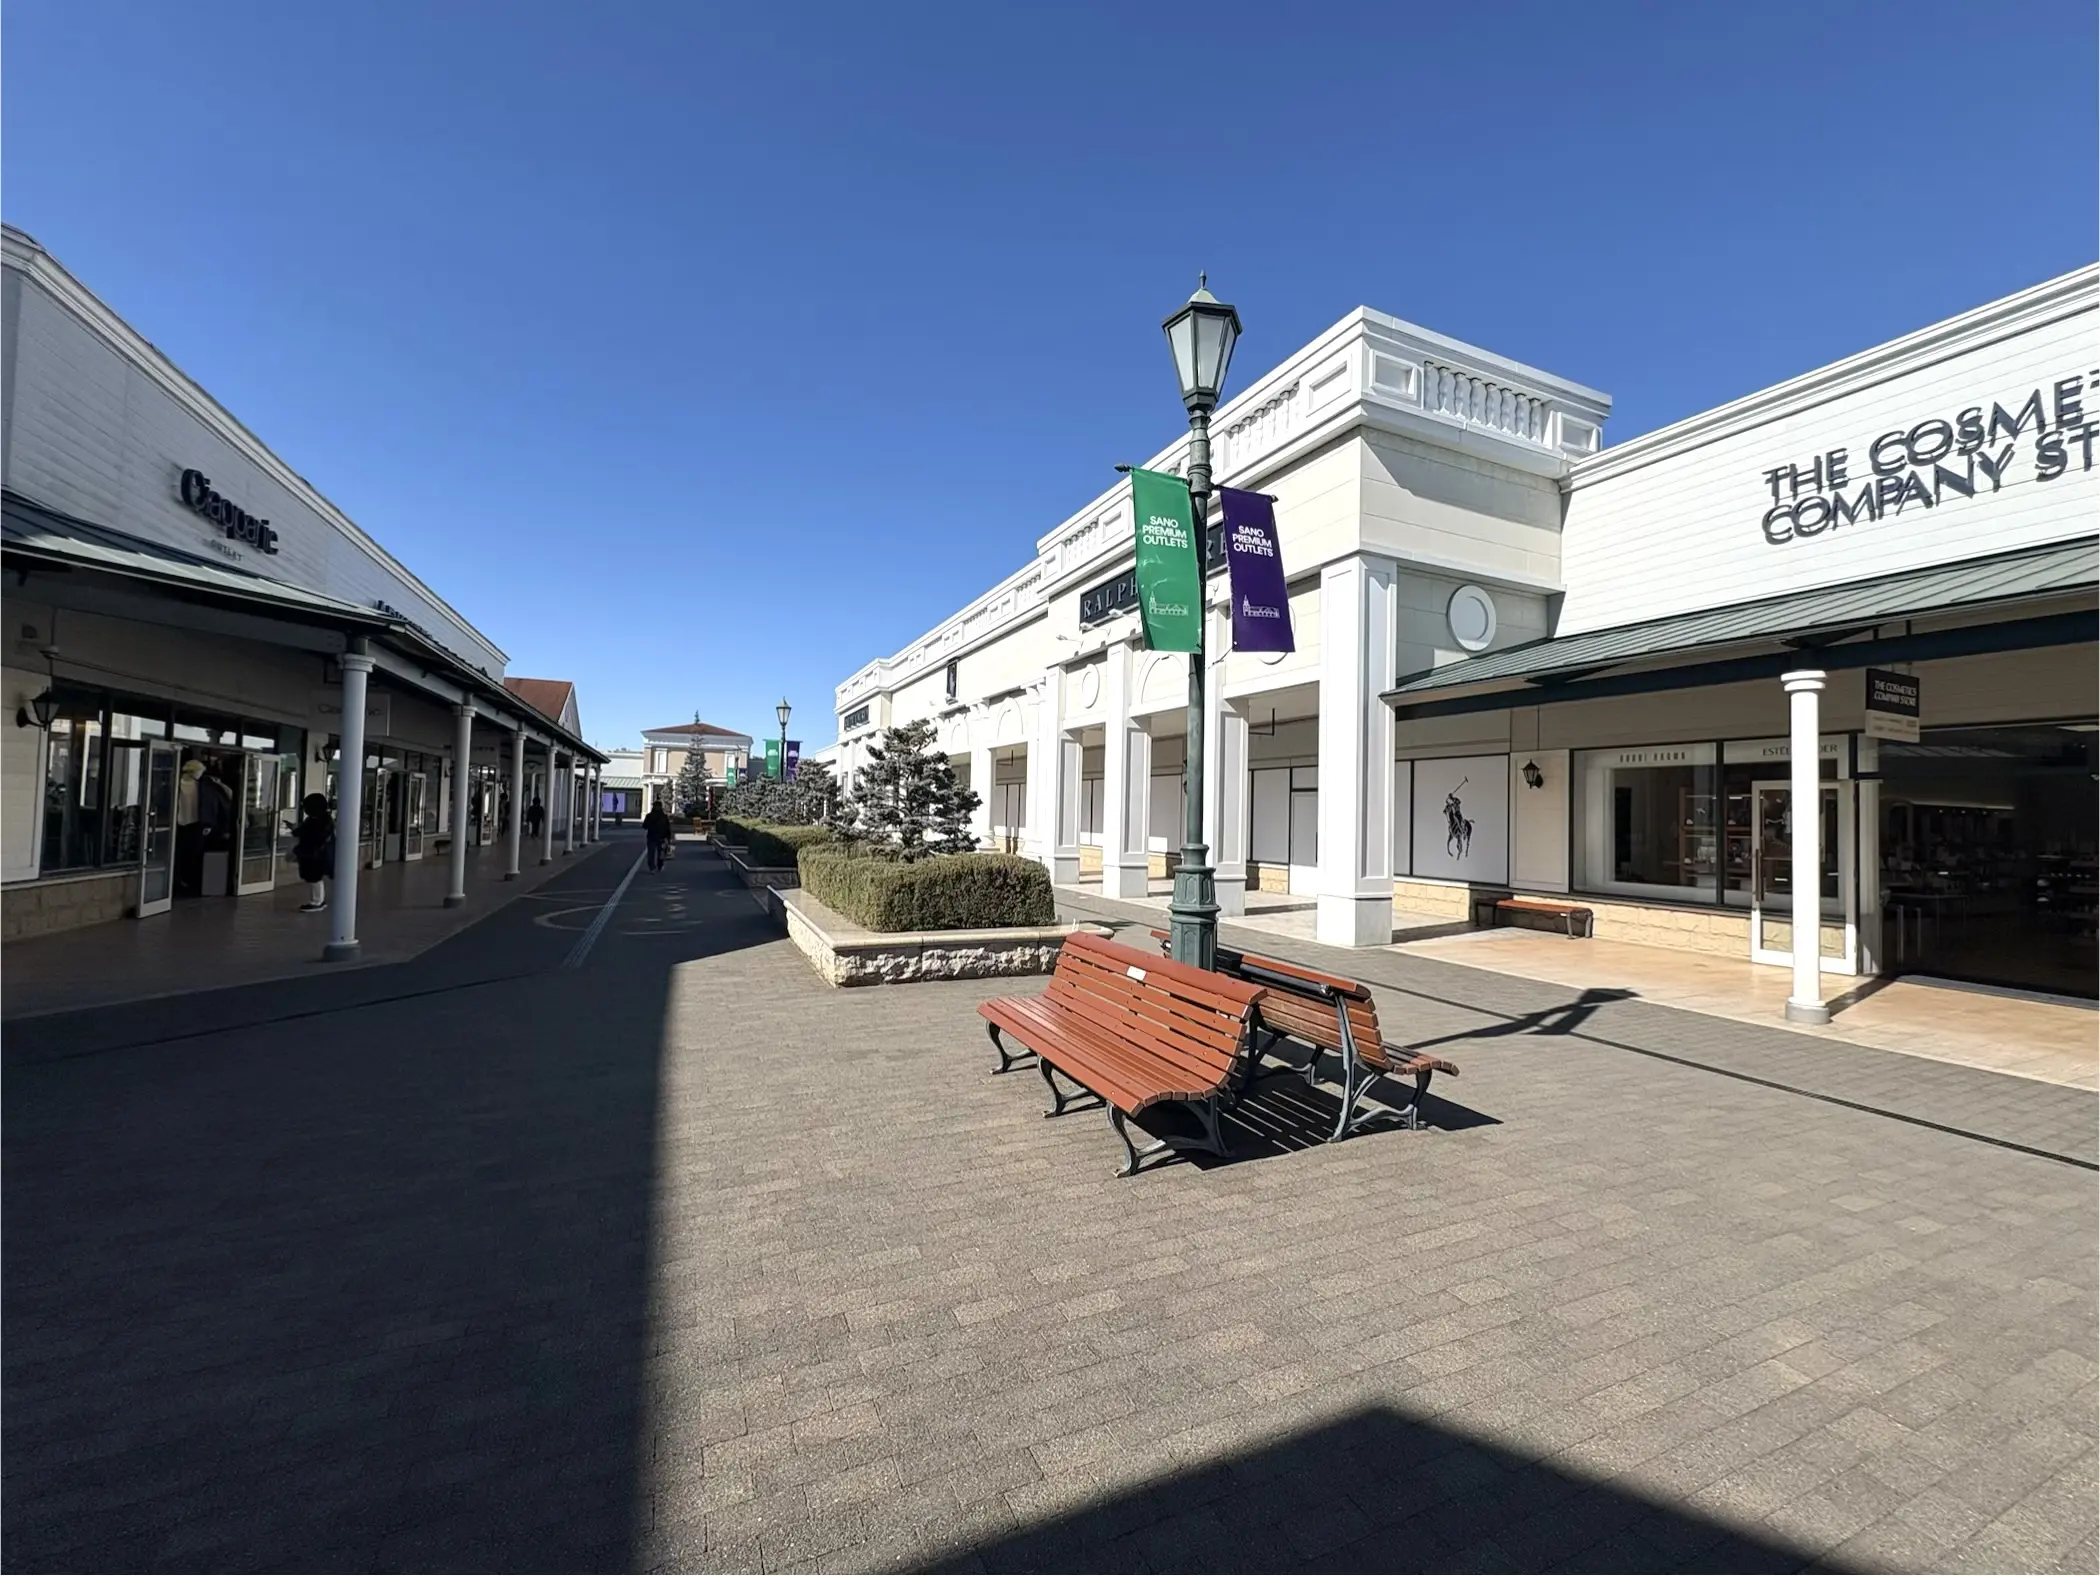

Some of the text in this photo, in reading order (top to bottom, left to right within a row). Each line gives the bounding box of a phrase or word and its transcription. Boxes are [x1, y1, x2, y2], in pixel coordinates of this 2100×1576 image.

[1762, 448, 1849, 505] THE
[1762, 443, 2015, 545] COMPANY
[1150, 516, 1179, 529] SANO
[1142, 525, 1188, 539] PREMIUM
[1238, 525, 1265, 538] SANO
[1143, 535, 1188, 549] OUTLETS
[1232, 533, 1272, 548] PREMIUM
[1233, 543, 1274, 557] OUTLETS
